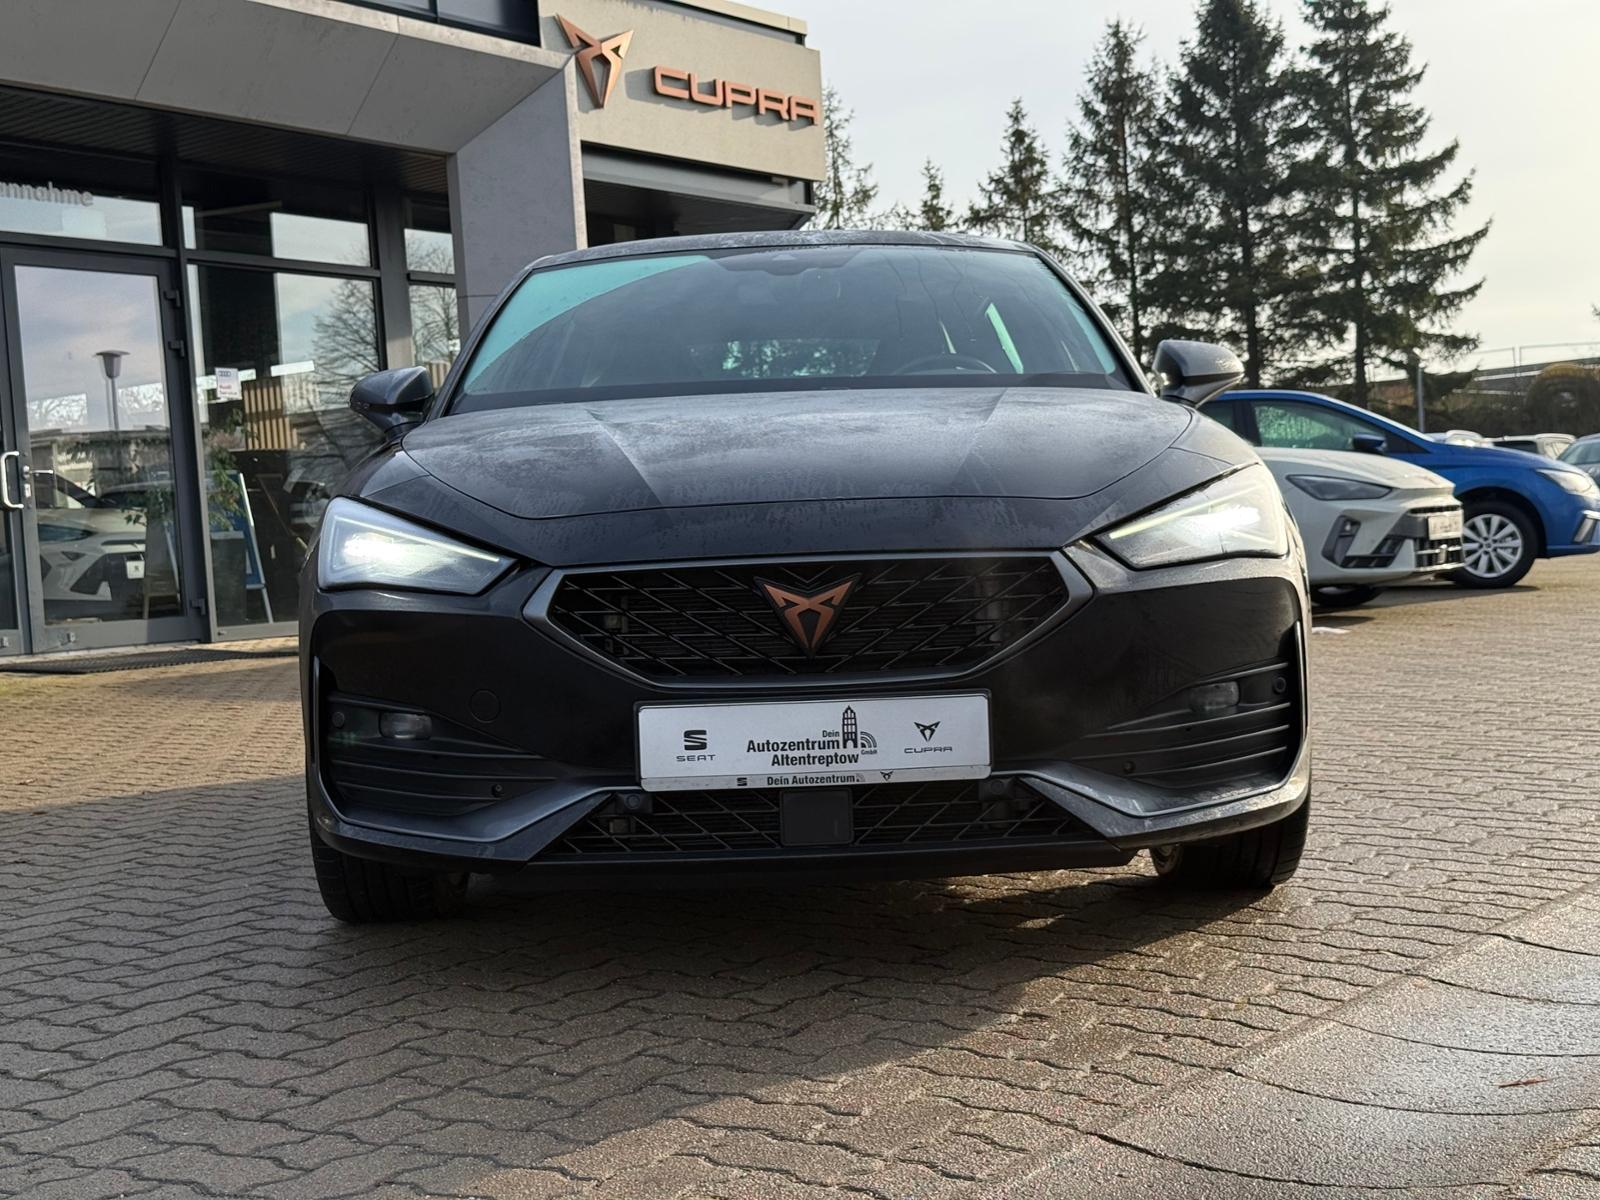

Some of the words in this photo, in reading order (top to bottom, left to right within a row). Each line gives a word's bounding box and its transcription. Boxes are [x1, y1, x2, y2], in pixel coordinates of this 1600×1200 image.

[653, 64, 818, 125] CUPRA
[822, 729, 840, 738] Dein
[746, 738, 840, 753] Autozentrum
[903, 746, 953, 754] CUPRA
[676, 754, 716, 762] SEAT
[771, 752, 860, 767] Altentreptow
[766, 776, 790, 786] Dein
